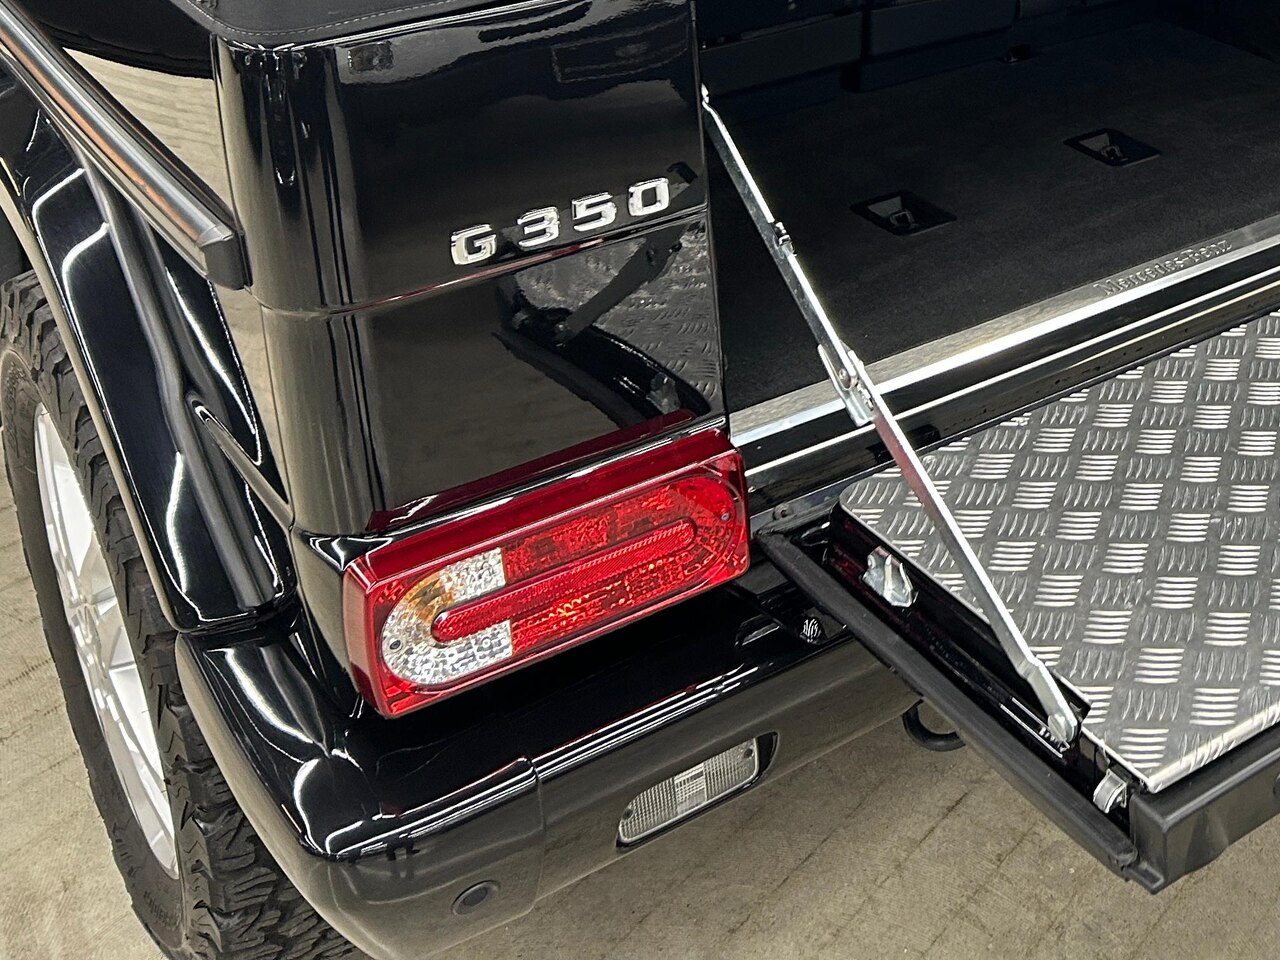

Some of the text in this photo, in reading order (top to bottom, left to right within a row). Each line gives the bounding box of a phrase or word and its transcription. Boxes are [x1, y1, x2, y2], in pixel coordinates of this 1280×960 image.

[451, 177, 670, 266] G 350
[1093, 239, 1233, 296] Mercedes-Benz
